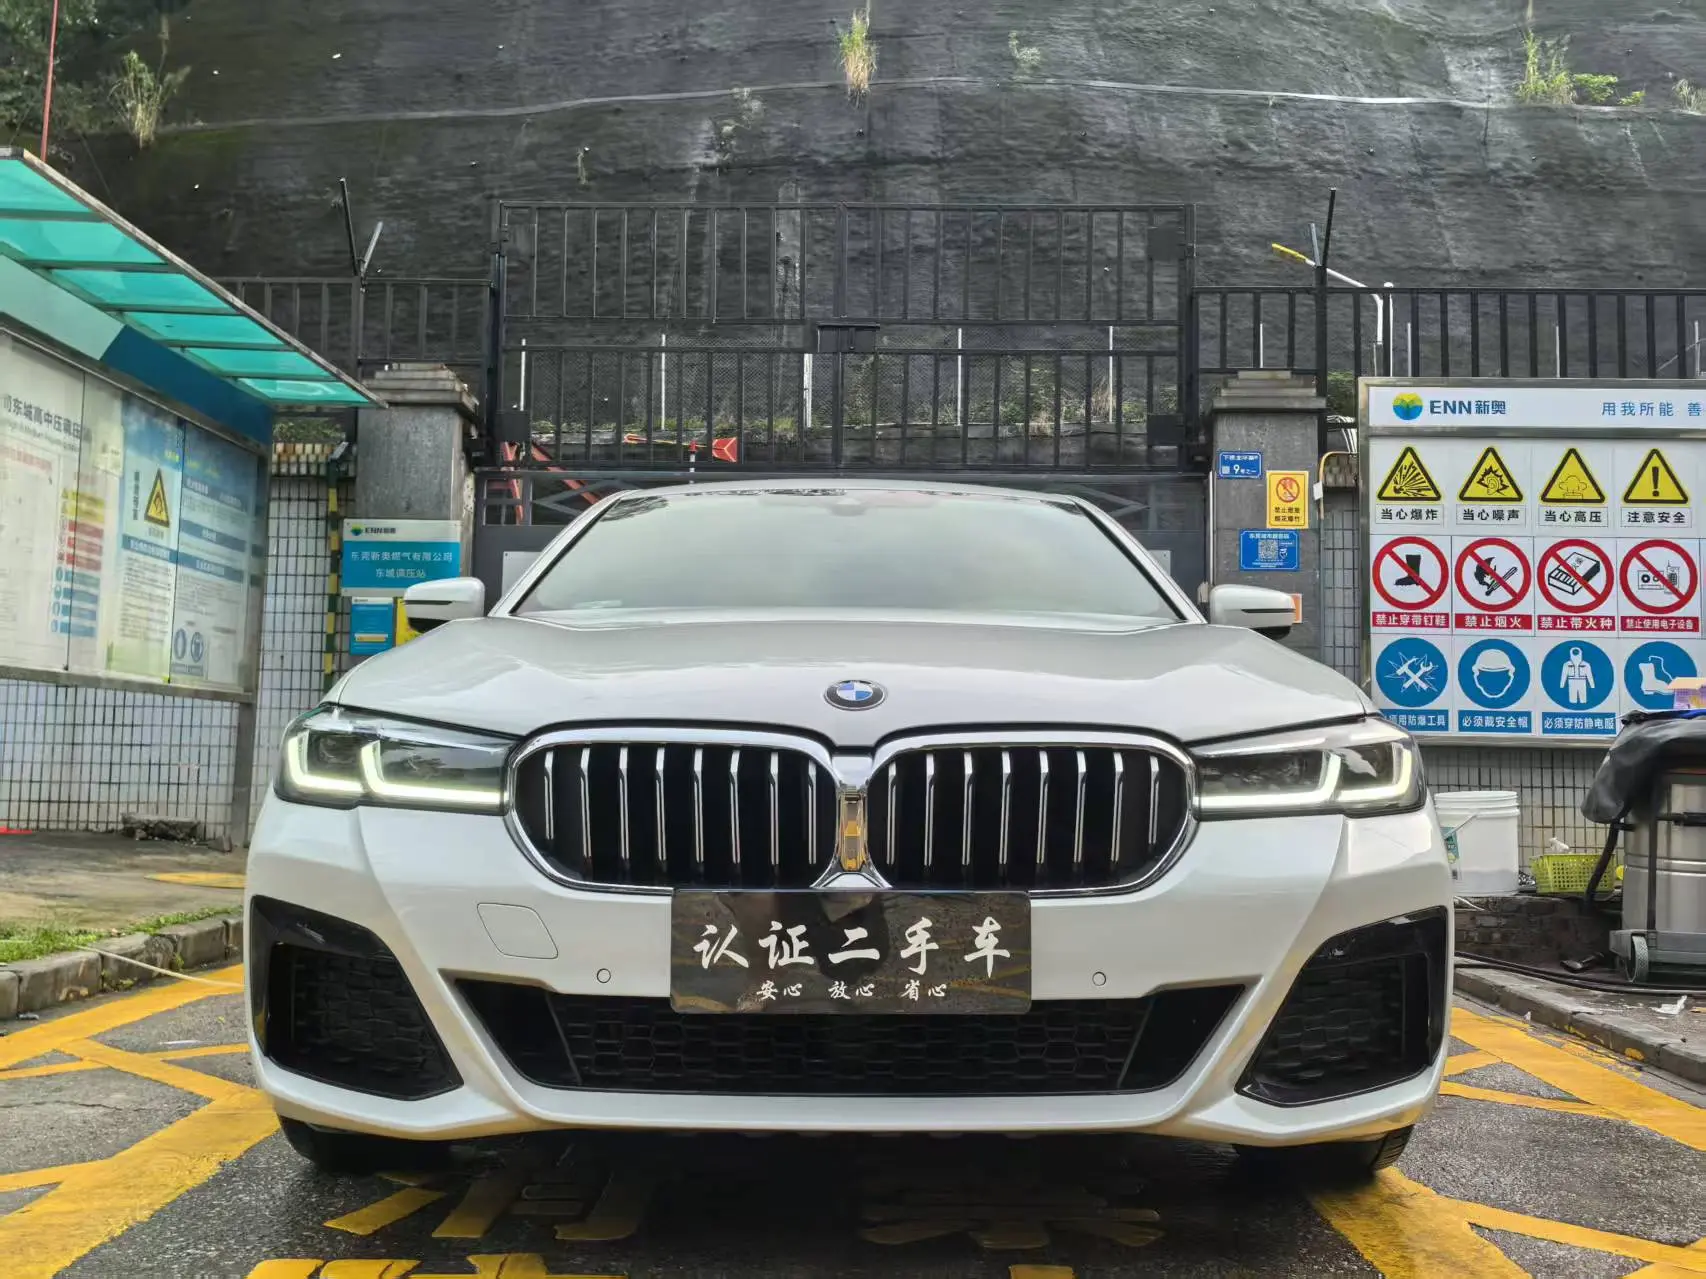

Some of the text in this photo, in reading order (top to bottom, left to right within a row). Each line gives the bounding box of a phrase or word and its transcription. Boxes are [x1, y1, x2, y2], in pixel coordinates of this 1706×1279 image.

[1429, 399, 1507, 415] ENN新奥
[1601, 401, 1675, 417] 用我所能
[1381, 508, 1438, 521] 当心爆炸
[1462, 508, 1520, 521] 当心噪声
[1544, 509, 1602, 523] 当心高压
[1627, 510, 1686, 524] 注意安全
[1375, 614, 1447, 627] 禁止穿带钉鞋
[1464, 615, 1522, 629] 禁止烟火
[1540, 616, 1613, 630] 禁止带火种
[1625, 618, 1694, 630] 禁止使用电子设备
[1462, 715, 1529, 729] 必须戴安全帽
[1543, 716, 1615, 730] 必须穿防静电服
[693, 916, 1011, 979] 认证二手车
[757, 980, 947, 1001] 安心 放心 省心
